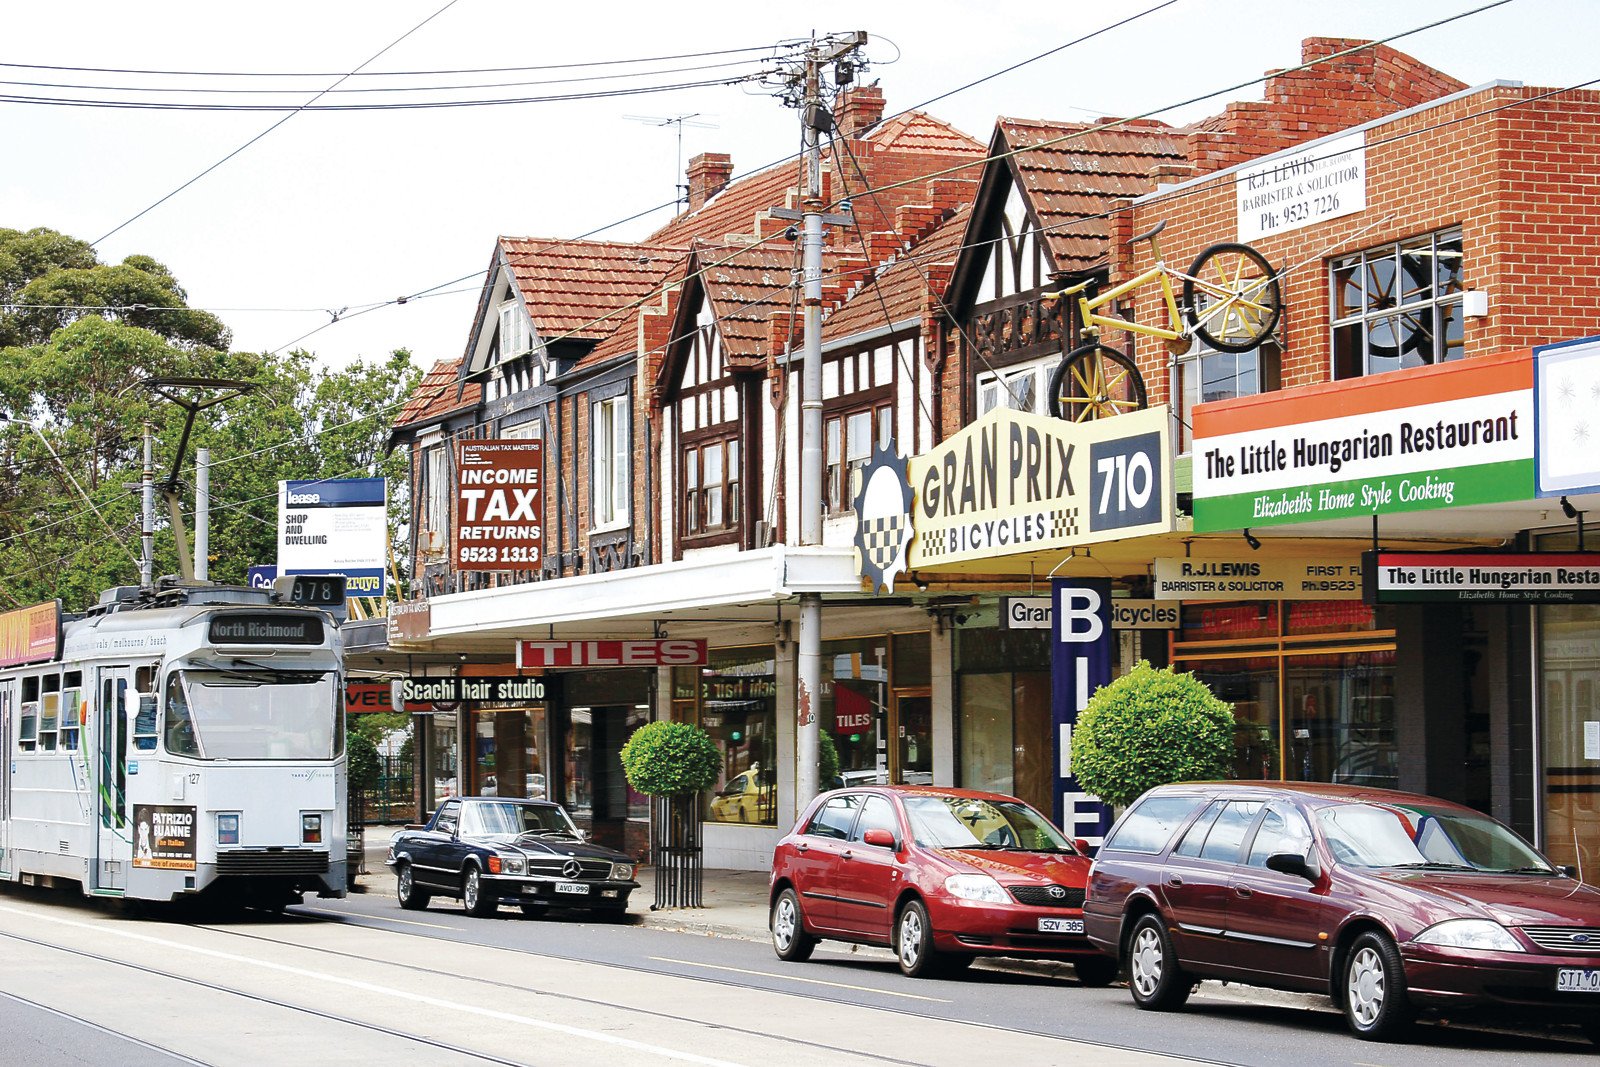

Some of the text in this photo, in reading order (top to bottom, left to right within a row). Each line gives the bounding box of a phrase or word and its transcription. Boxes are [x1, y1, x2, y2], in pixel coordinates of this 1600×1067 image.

[1274, 155, 1315, 183] LEWIS
[1243, 166, 1358, 212] BARRISTER & SOLICITOR
[1261, 192, 1340, 231] Ph: 9523 7226
[1205, 409, 1519, 479] The Little Hungarian Restaurant
[461, 468, 539, 485] INCOME
[923, 421, 1076, 519] GRAN PRIX
[1097, 451, 1153, 515] 710
[287, 491, 320, 504] lease
[460, 488, 539, 522] TAX
[1253, 475, 1455, 518] Elizabeth's Home Style Cooking
[285, 514, 308, 524] SHOP
[285, 525, 302, 535] AND
[459, 525, 541, 540] RETURNS
[949, 513, 1045, 553] BICYCLES
[285, 535, 328, 545] DWELLING
[460, 546, 539, 562] 9523 1313
[1307, 566, 1343, 576] FIRST
[1387, 568, 1416, 584] The
[1421, 568, 1464, 584] Little
[1469, 568, 1551, 588] Hungarian
[294, 582, 331, 600] 978
[1161, 581, 1216, 592] BARRISTER
[1217, 582, 1226, 592] &
[1227, 581, 1284, 592] SOLICITOR
[1459, 591, 1574, 601] Elizabeth's Home Style Cooking
[1112, 604, 1176, 625] icycles
[211, 622, 304, 637] North Richmond
[530, 641, 699, 665] TILES
[403, 679, 545, 700] Scachi hair studio
[837, 713, 870, 727] TILES
[188, 773, 200, 785] 127
[152, 812, 193, 825] PATRIZIO
[1043, 920, 1060, 930] SZV
